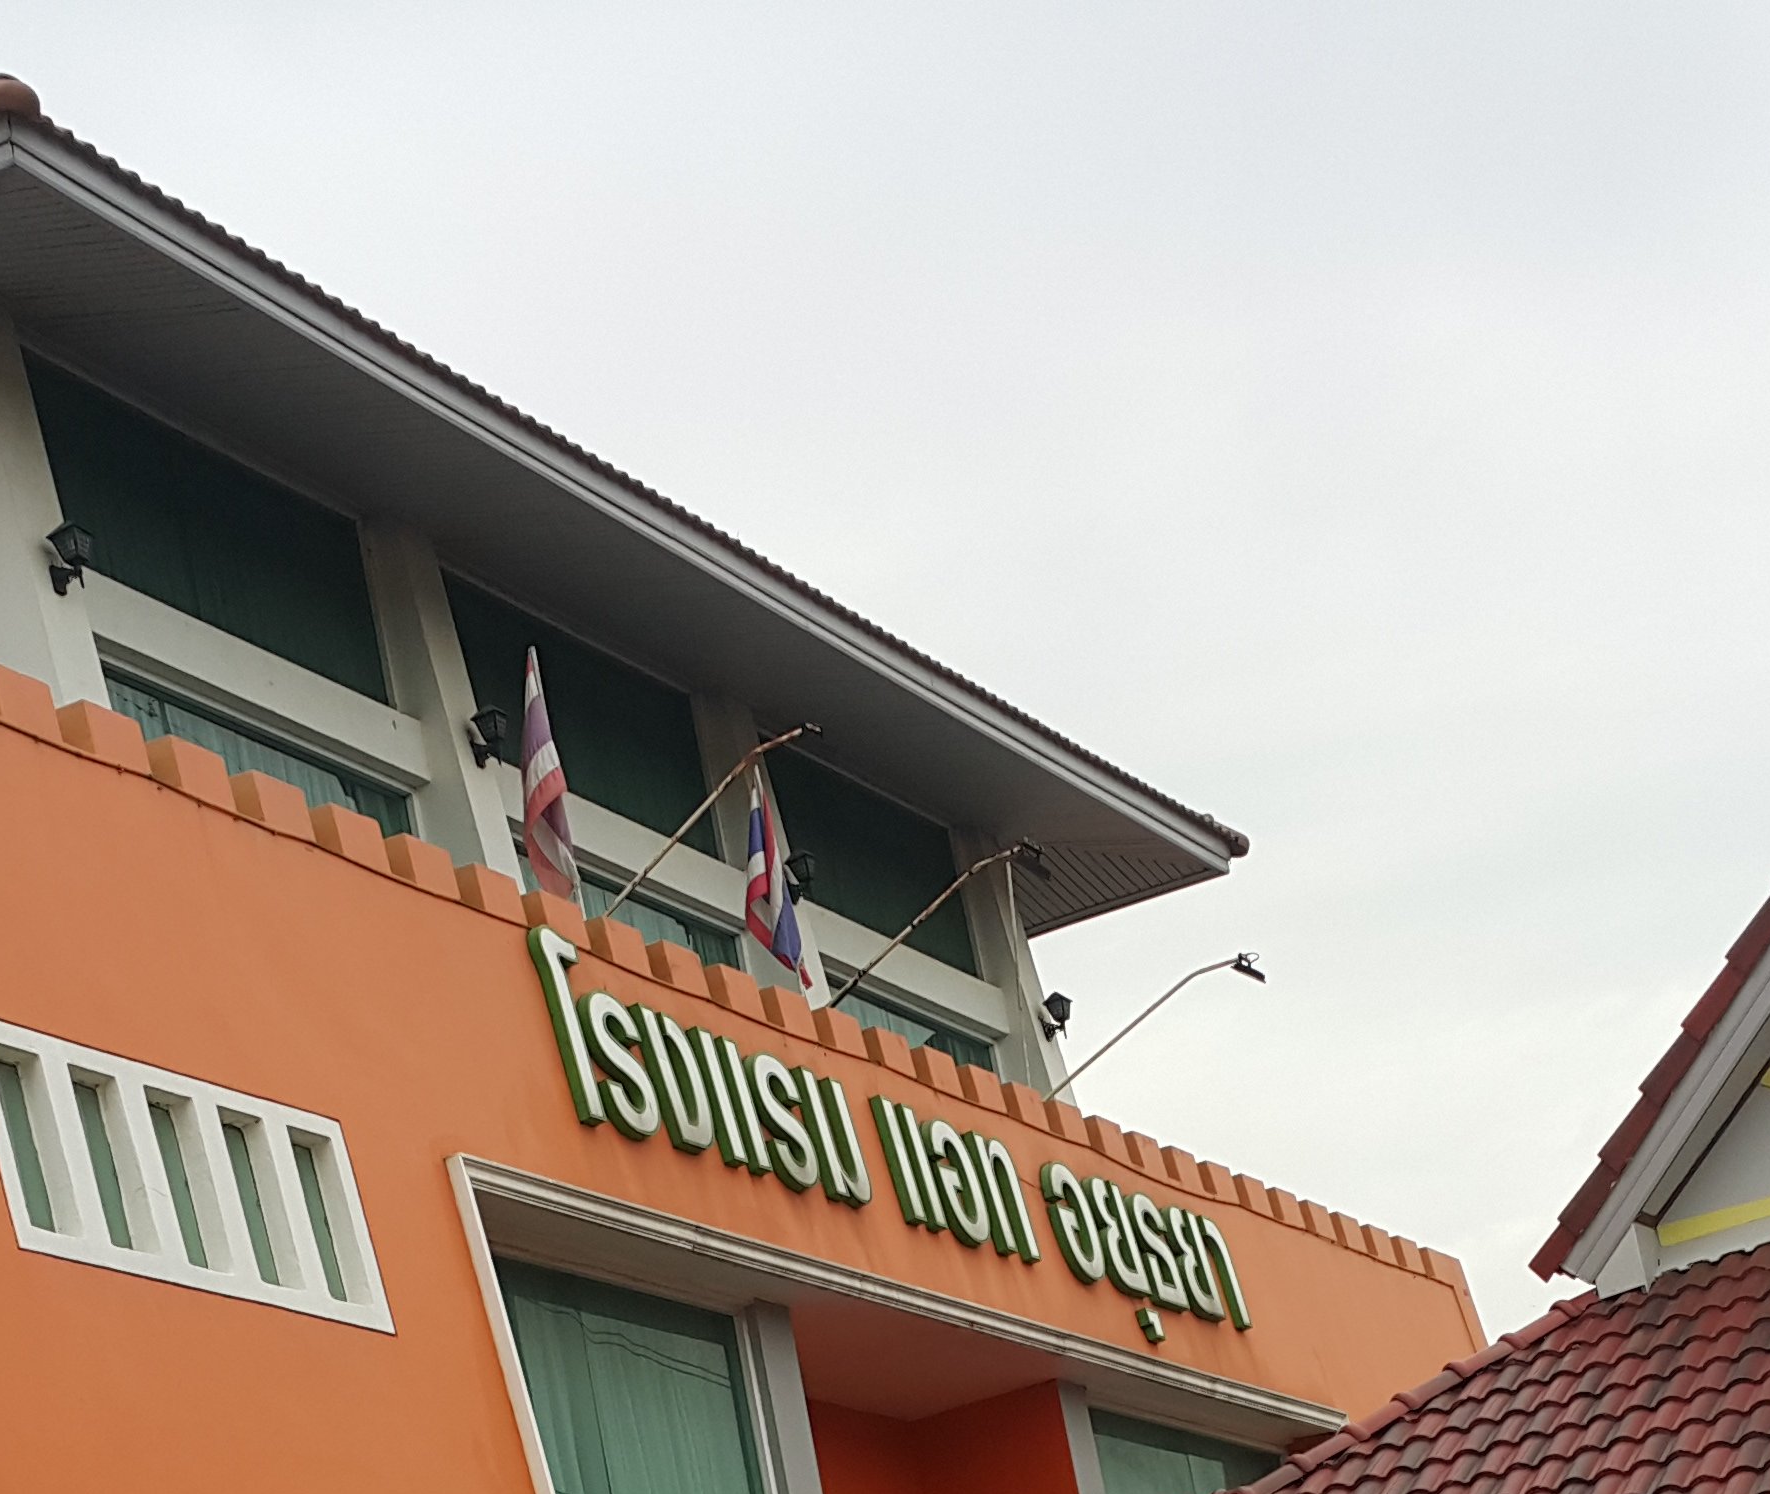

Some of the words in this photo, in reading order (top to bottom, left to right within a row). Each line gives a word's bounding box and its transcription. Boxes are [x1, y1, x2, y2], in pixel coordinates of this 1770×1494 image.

[527, 924, 872, 1209] โรงแรม
[870, 1094, 1042, 1265] แอท
[1040, 1161, 1252, 1344] อยุธยา
